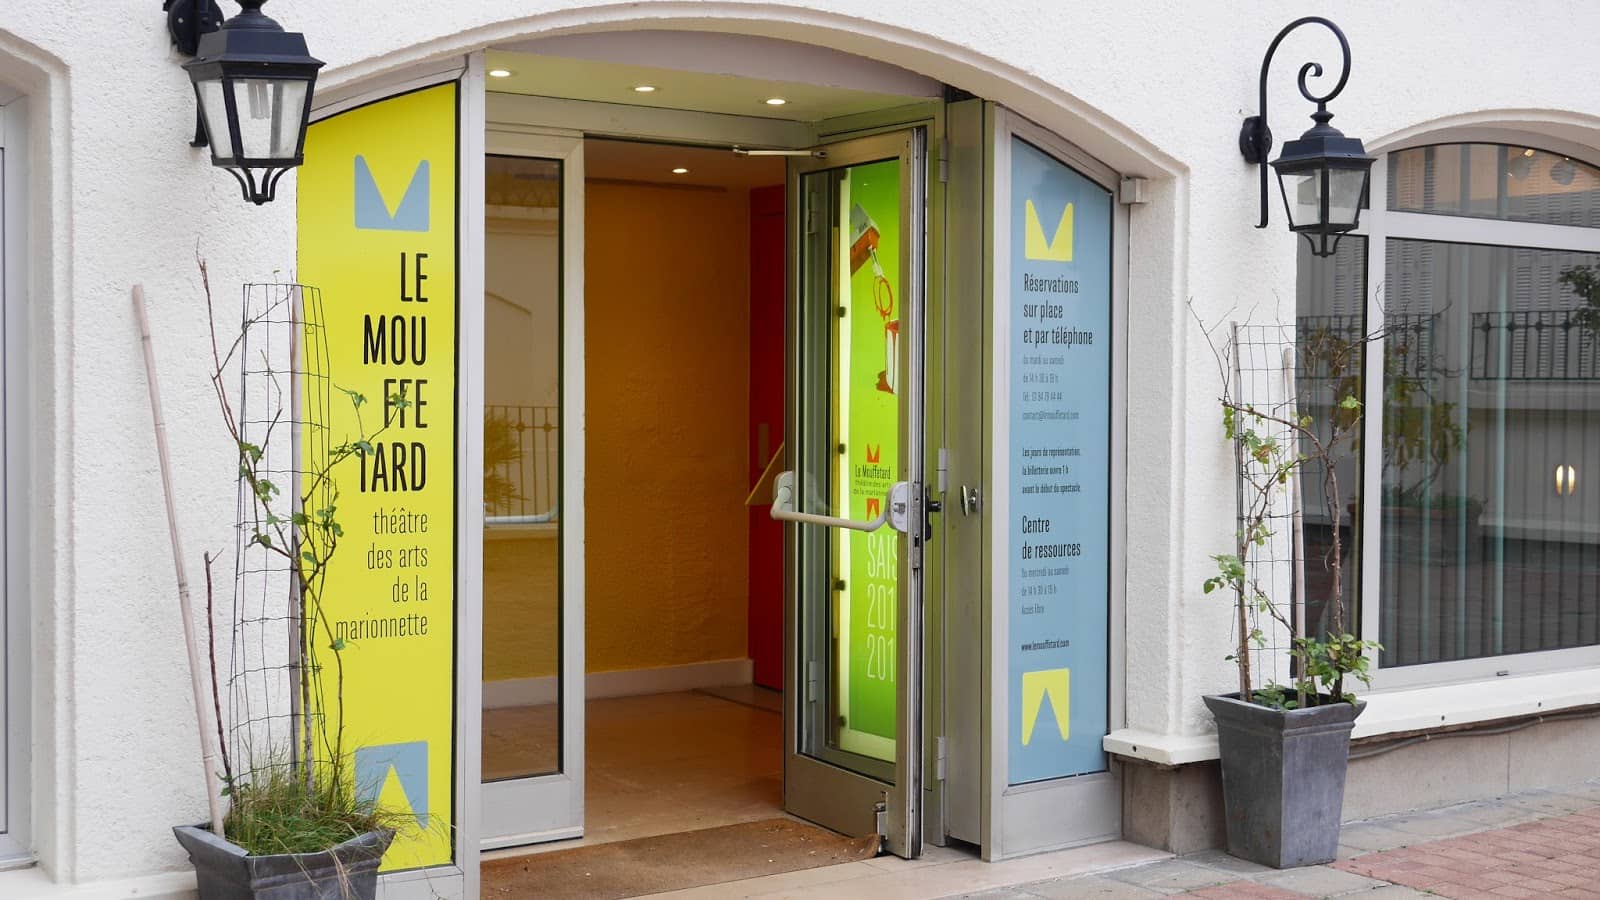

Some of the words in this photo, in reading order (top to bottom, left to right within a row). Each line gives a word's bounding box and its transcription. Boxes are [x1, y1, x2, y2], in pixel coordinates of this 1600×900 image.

[400, 252, 428, 302] LE
[1024, 273, 1079, 294] Réservations
[1023, 303, 1038, 318] sur
[1040, 300, 1063, 323] place
[363, 314, 427, 365] MOU
[1023, 328, 1033, 344] et
[1035, 329, 1049, 349] par
[1051, 325, 1093, 349] téléphone
[384, 378, 428, 428] FFE
[862, 464, 891, 480] Mouffetard
[373, 507, 428, 535] théâtre
[1022, 515, 1050, 535] Centre
[367, 542, 393, 569] des
[399, 545, 428, 568] arts
[1022, 540, 1032, 560] de
[1034, 543, 1081, 559] ressources
[392, 576, 409, 603] de
[415, 575, 428, 601] la
[335, 612, 428, 642] marionnette
